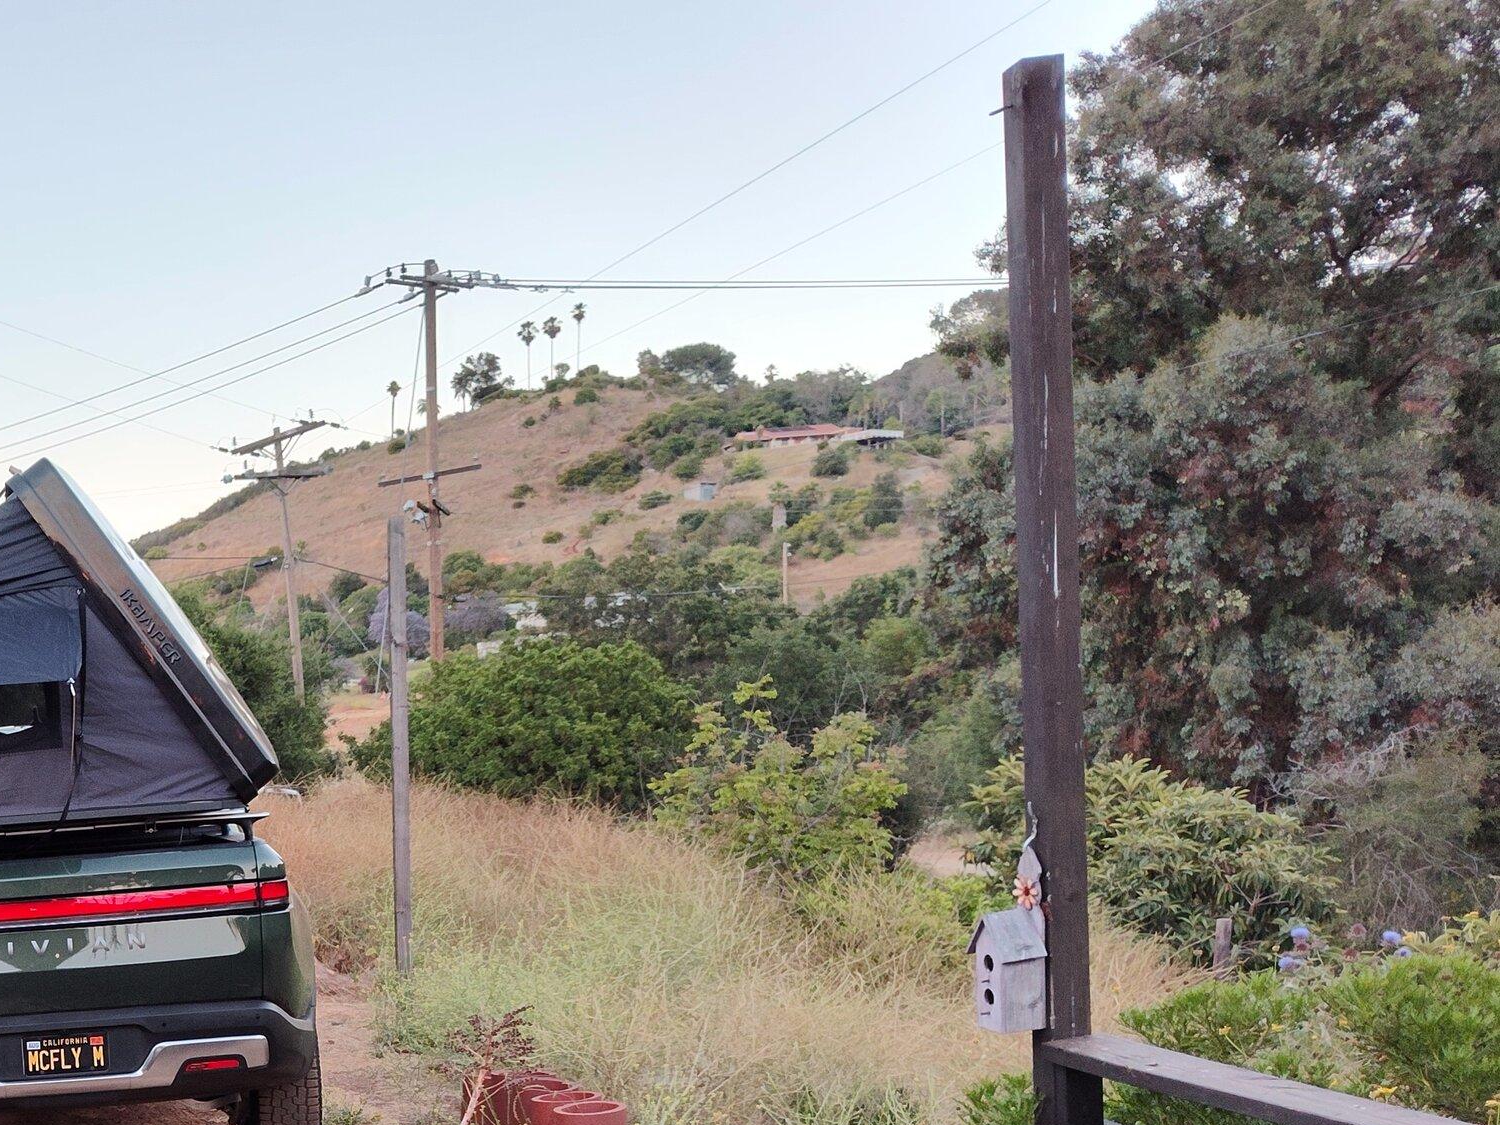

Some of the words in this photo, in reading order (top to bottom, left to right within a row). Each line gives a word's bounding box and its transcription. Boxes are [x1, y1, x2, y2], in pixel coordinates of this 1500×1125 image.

[42, 1037, 88, 1047] CALIFORNIA
[28, 1047, 81, 1072] MCFLY
[92, 1045, 104, 1067] M
